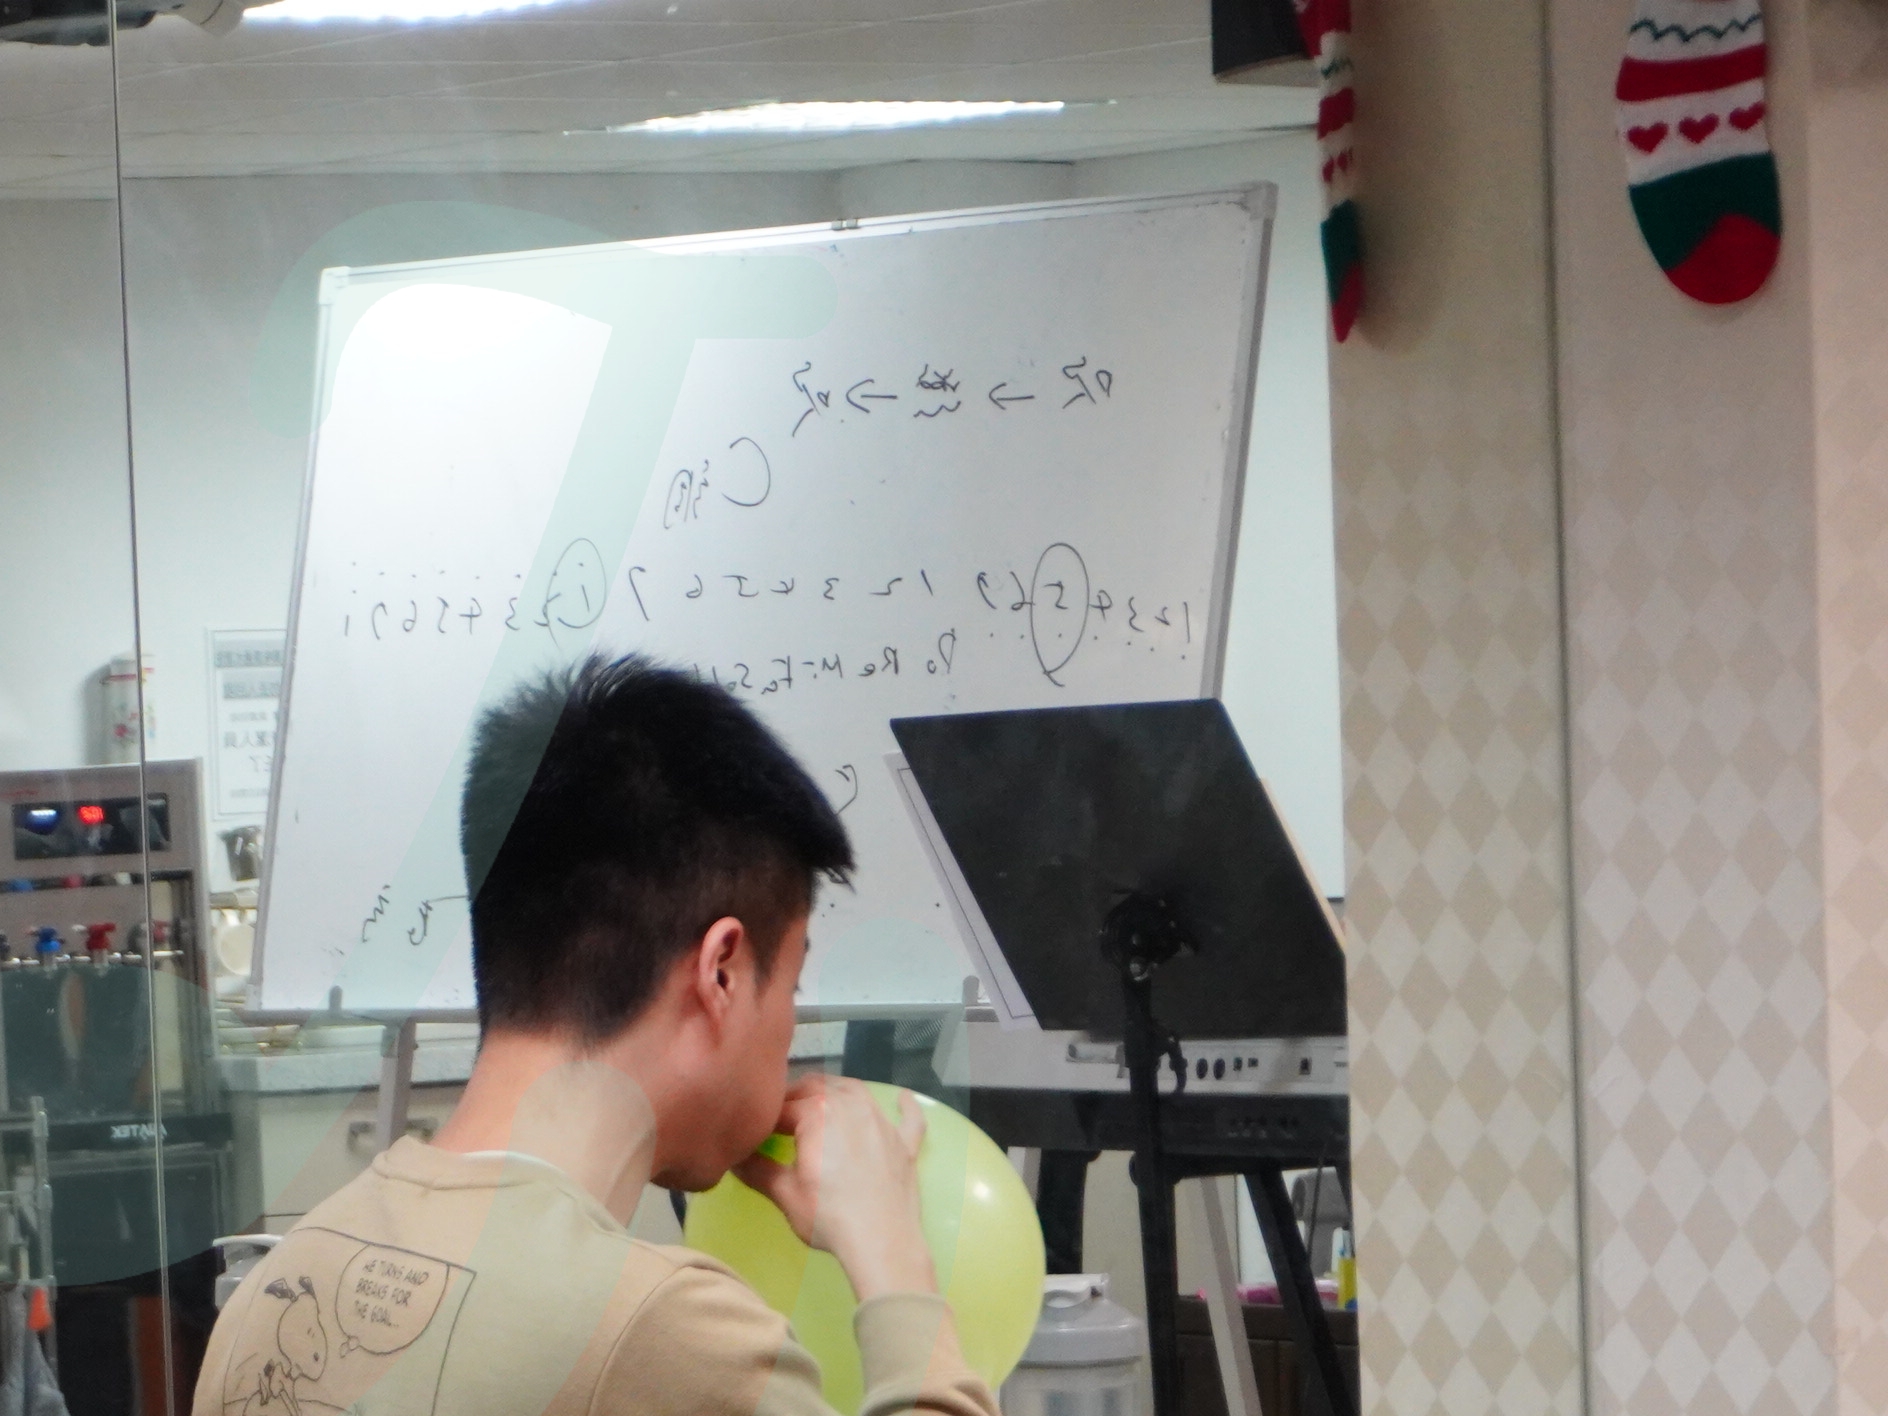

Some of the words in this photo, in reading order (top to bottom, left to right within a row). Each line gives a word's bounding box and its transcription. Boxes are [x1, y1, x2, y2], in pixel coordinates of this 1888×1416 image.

[403, 1267, 430, 1286] AND
[355, 1277, 389, 1300] BREAKS
[391, 1286, 412, 1307] FOR
[354, 1299, 369, 1319] THE
